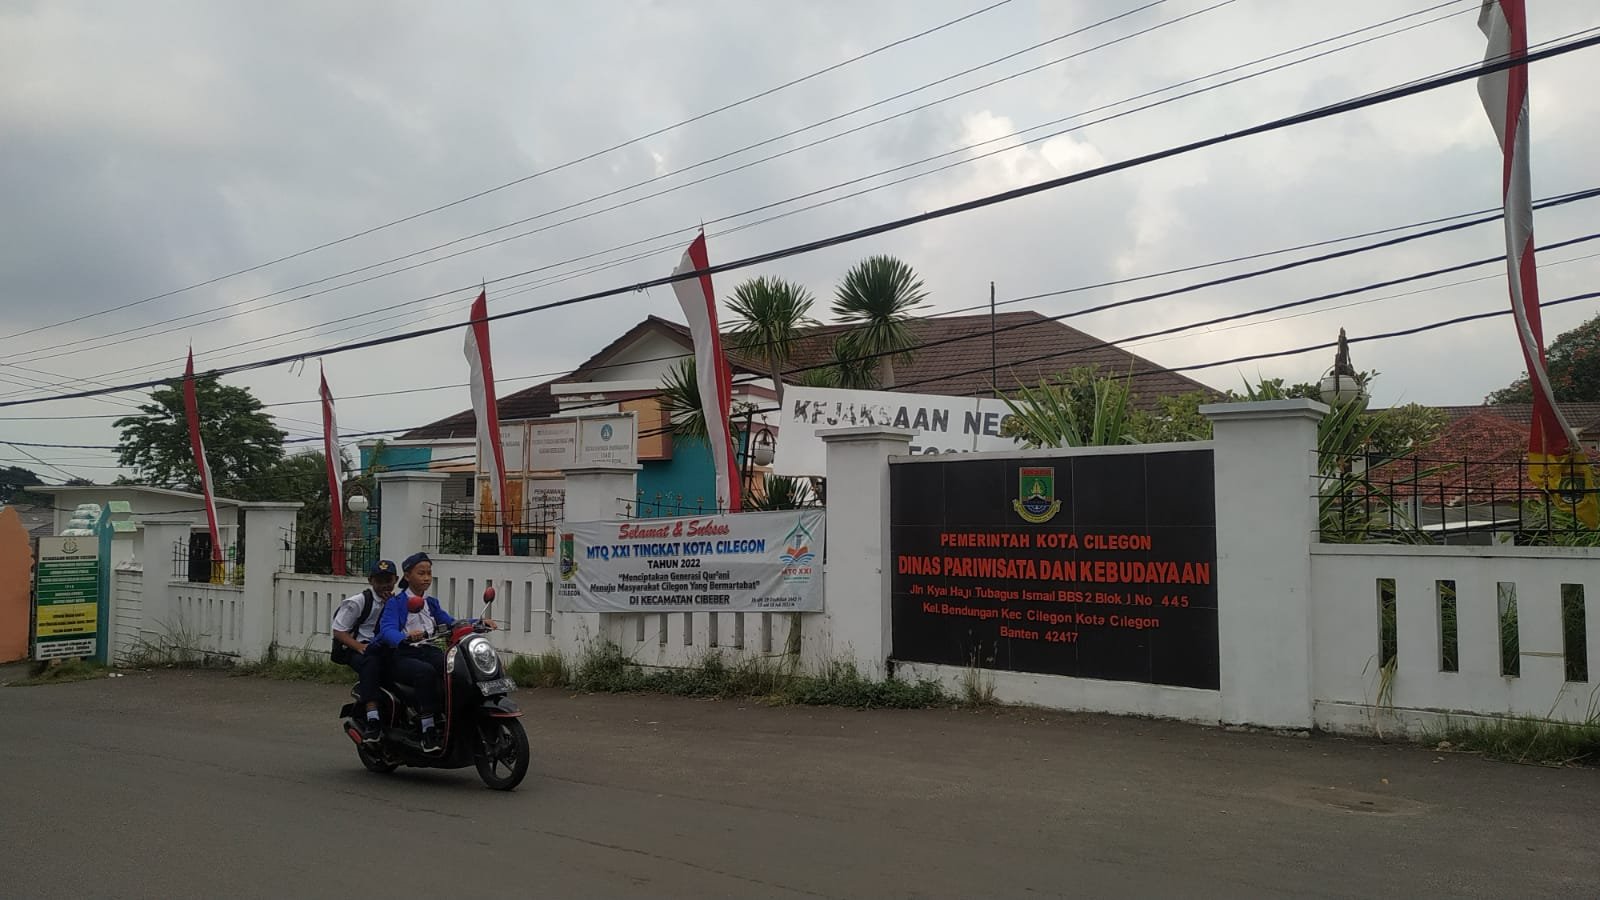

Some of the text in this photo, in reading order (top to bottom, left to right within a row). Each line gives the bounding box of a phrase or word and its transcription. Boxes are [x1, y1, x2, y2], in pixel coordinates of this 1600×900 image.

[618, 519, 730, 540] Selamat & Sukses
[587, 539, 766, 560] MTQ XXI TINGKAT KOTA CILEGON
[940, 533, 1152, 550] PEMERINTAH KOTA CILEGON
[647, 558, 701, 570] TAHUN 2022
[898, 555, 1210, 585] DINAS PARIWISATA DAN KEBUDAYAAN
[670, 571, 701, 581] Generasi
[590, 583, 616, 595] Menuju
[617, 580, 660, 594] Masyarakat
[661, 579, 690, 592] Cilegon
[690, 579, 709, 592] Yang
[629, 593, 731, 606] DI KECAMATAN CIBEBER
[910, 584, 924, 595] Jln
[927, 585, 948, 598] Kyai
[950, 586, 972, 599] Haji
[975, 587, 1019, 601] Tubagus
[1022, 589, 1056, 601] Ismail
[1058, 590, 1084, 602] BBS
[1084, 592, 1093, 602] 2
[1095, 592, 1123, 605] Blok
[1134, 593, 1154, 606] No
[1161, 595, 1190, 608] 445
[942, 604, 999, 620] Bendungan
[1002, 608, 1023, 620] Kec
[1027, 610, 1073, 625] Cilegon
[1075, 612, 1106, 625] Kota
[1110, 614, 1160, 629] Cilegon
[1000, 626, 1079, 642] Banten 42417
